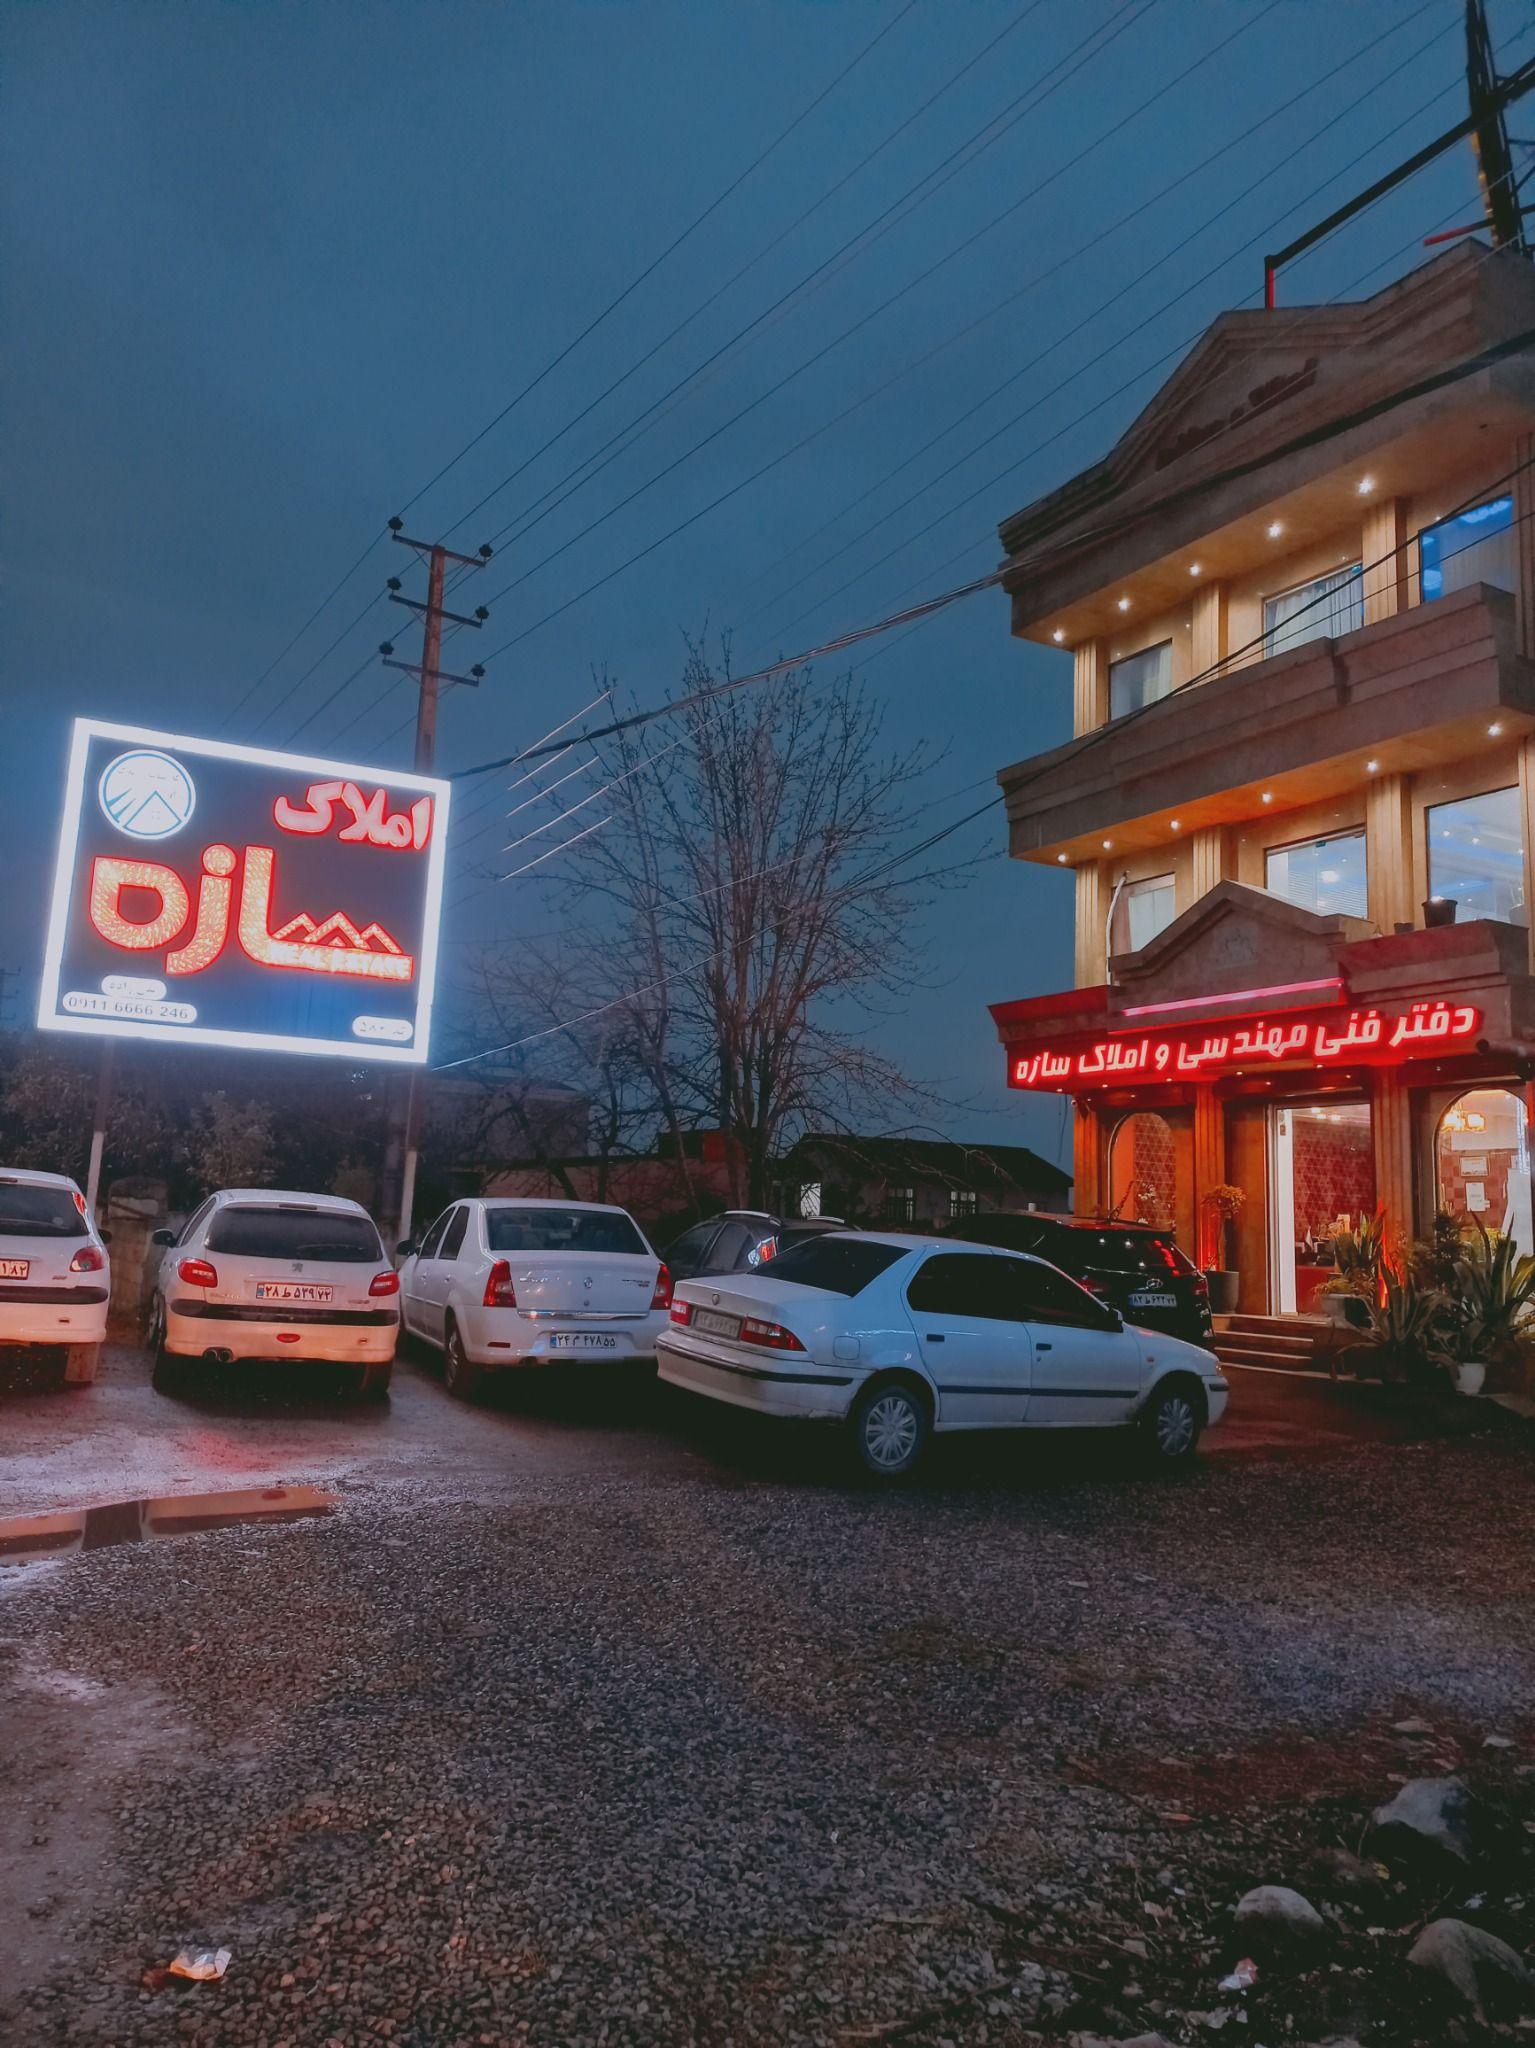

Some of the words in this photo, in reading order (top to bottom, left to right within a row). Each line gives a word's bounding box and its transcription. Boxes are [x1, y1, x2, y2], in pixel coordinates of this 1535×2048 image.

[274, 780, 432, 850] املاک
[89, 843, 414, 982] سازه
[68, 996, 108, 1012] 0911
[114, 1000, 154, 1016] 6666
[159, 1005, 189, 1020] 246
[1388, 1001, 1475, 1048] دفتر
[1078, 1039, 1149, 1073] املاک
[1177, 1021, 1308, 1070] مهندسی
[1313, 1009, 1381, 1057] فنی
[1016, 1051, 1071, 1083] سازه
[1154, 1043, 1170, 1071] و
